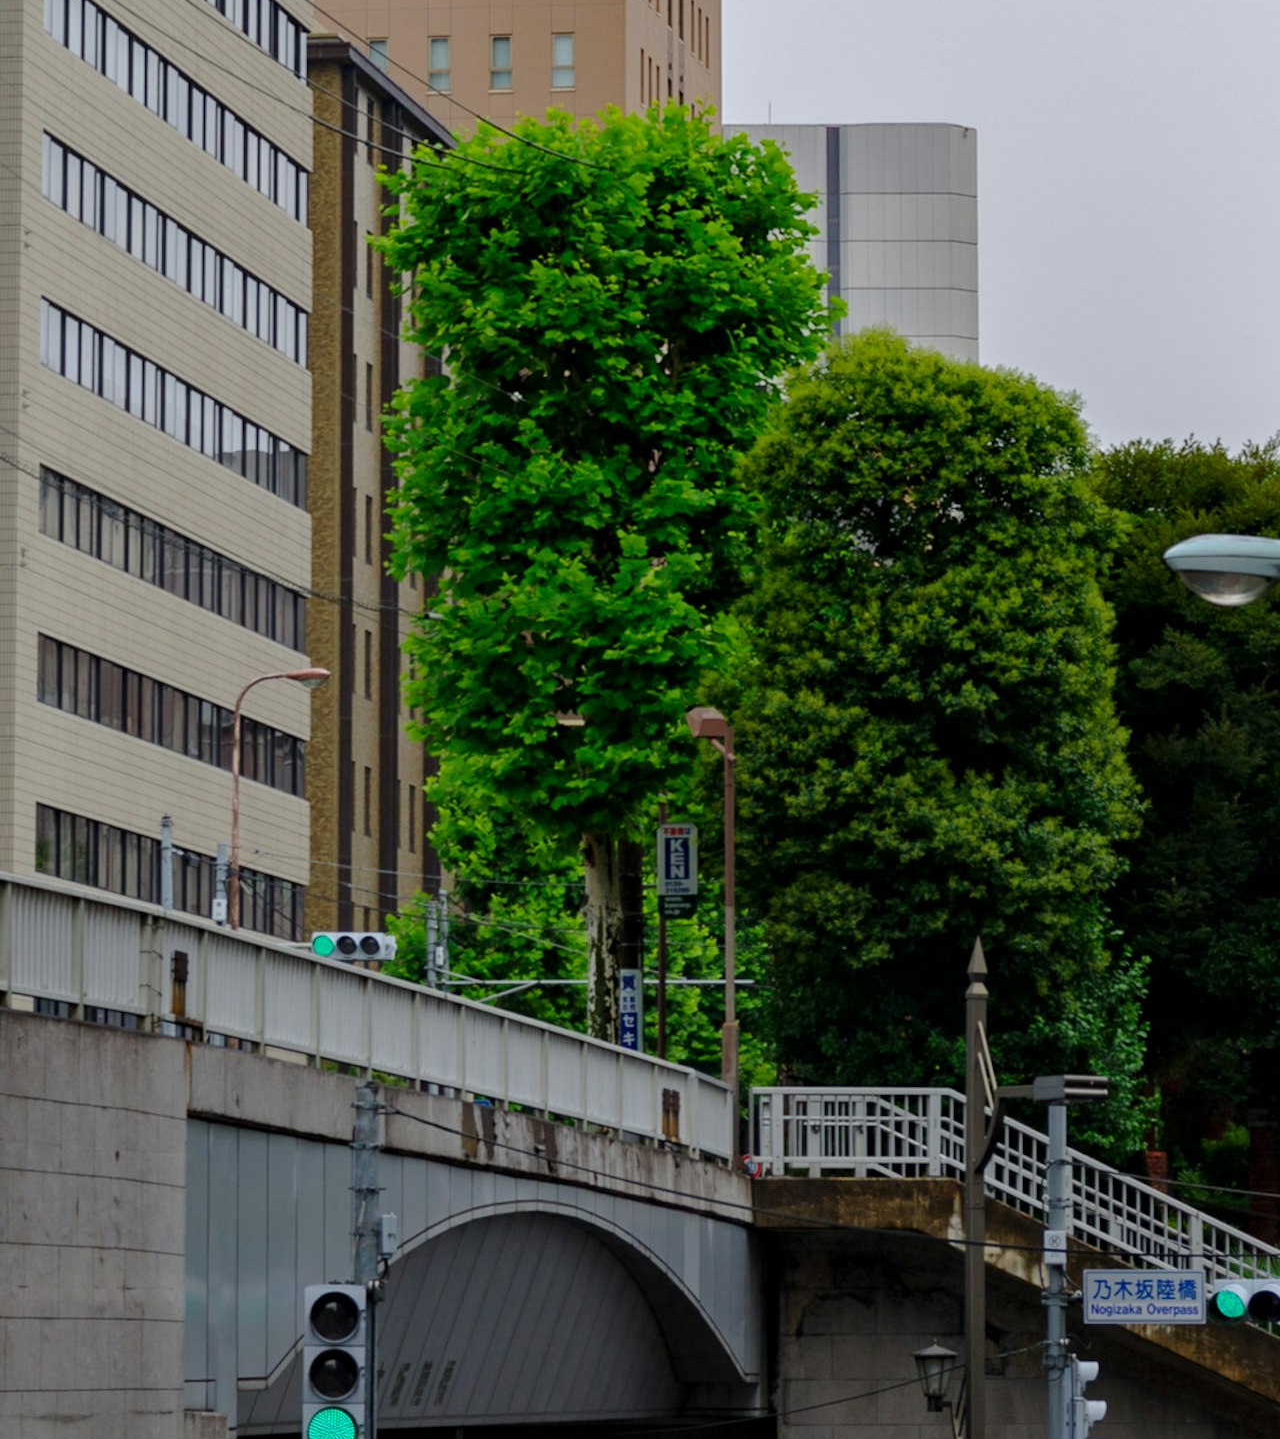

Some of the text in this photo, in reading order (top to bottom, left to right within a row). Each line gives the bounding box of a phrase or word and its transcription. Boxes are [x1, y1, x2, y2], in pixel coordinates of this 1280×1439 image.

[670, 839, 685, 879] KEN
[622, 1014, 636, 1047] セキ
[1092, 1278, 1198, 1300] 乃木坂陸橋
[1091, 1303, 1199, 1317] Nogizaka Overpass
